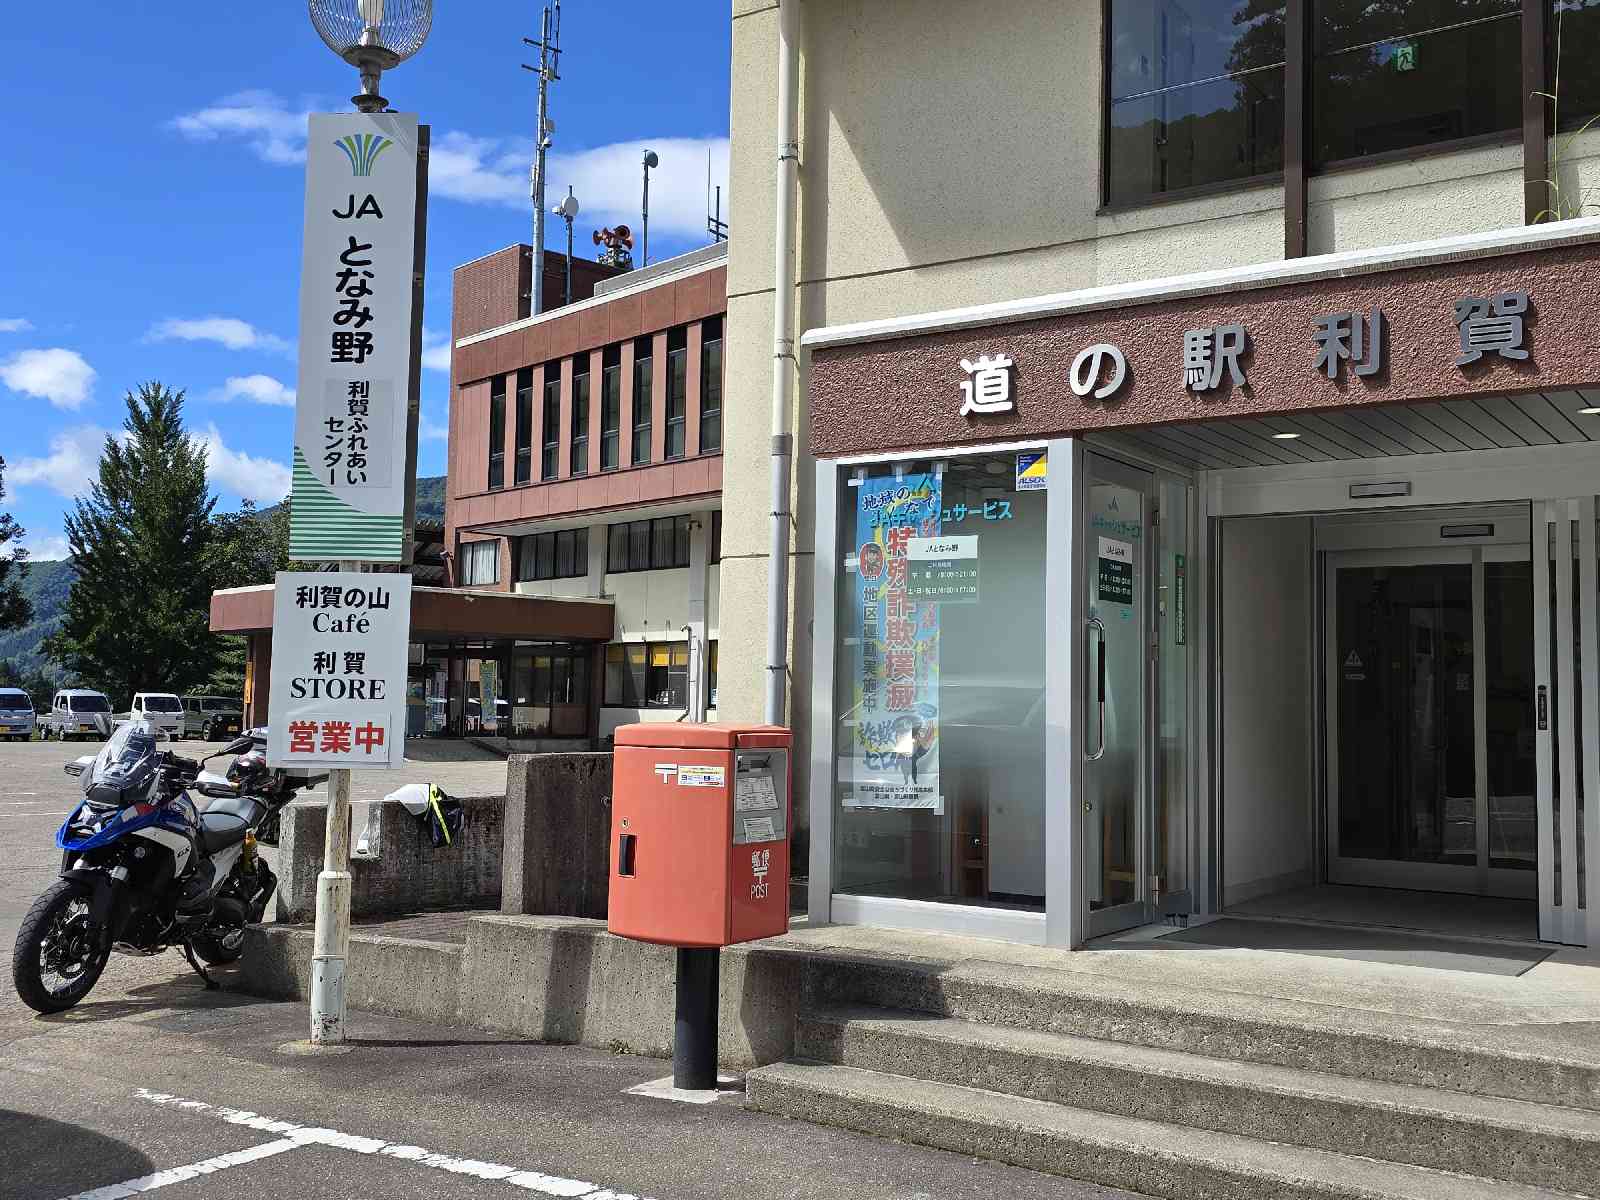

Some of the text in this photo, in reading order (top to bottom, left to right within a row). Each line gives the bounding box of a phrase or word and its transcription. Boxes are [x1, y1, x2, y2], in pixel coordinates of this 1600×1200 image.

[332, 194, 383, 219] JA
[330, 236, 374, 364] となみ野
[959, 288, 1529, 416] 道の駅利賀
[346, 380, 369, 485] 利賀ふれあい
[324, 416, 344, 485] センター
[296, 585, 390, 610] 利賀の山
[312, 612, 370, 634] Café
[290, 677, 386, 701] STORE
[288, 720, 385, 755] 営業中
[751, 883, 769, 900] POST
